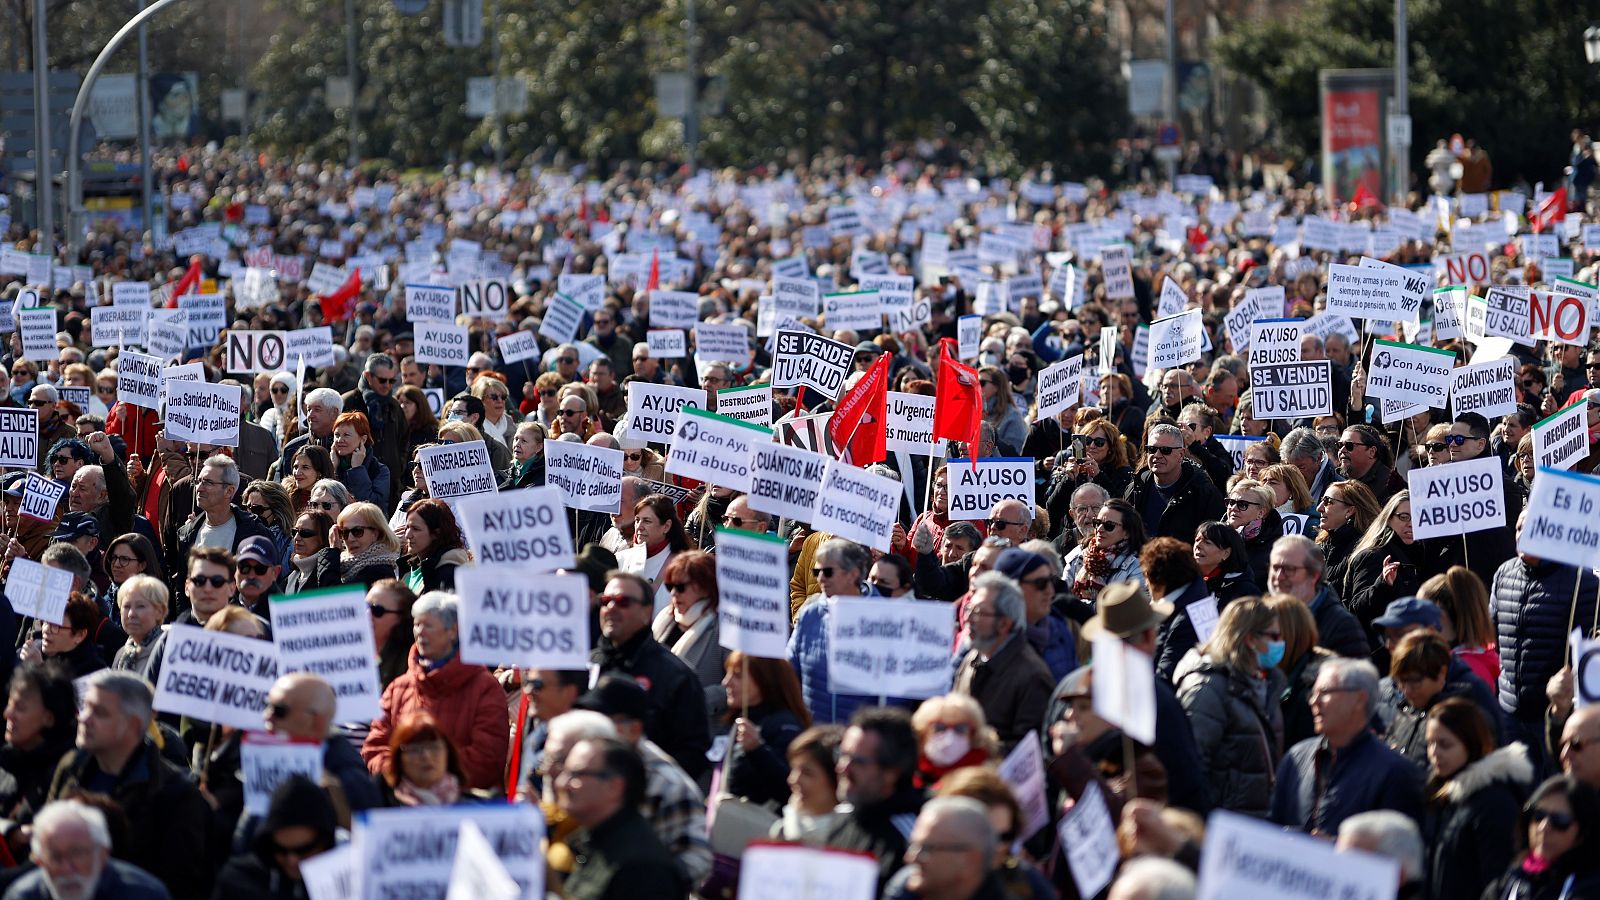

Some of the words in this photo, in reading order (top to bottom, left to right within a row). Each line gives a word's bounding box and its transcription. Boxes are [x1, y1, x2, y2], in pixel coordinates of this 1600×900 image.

[1333, 273, 1345, 282] Para
[1346, 274, 1351, 282] el
[1385, 278, 1398, 286] clero
[1446, 253, 1486, 284] NO
[414, 291, 449, 304] AY,USO
[464, 282, 504, 312] NO
[1340, 287, 1360, 296] siempre
[1362, 288, 1371, 298] hay
[1372, 289, 1390, 298] dinero.
[1404, 277, 1426, 294] MÁS
[1228, 296, 1260, 334] ROBAN
[1331, 298, 1343, 306] Para
[1344, 298, 1358, 308] salud
[1489, 293, 1502, 306] SE
[1507, 298, 1528, 317] VEN
[899, 303, 928, 330] NO
[1437, 318, 1449, 329] mil
[1486, 311, 1499, 328] TU
[1501, 317, 1528, 338] SALU
[1530, 293, 1585, 340] NO
[424, 331, 462, 344] AY,USO
[1154, 340, 1170, 352] ¡Con
[1172, 340, 1179, 348] la
[1180, 335, 1196, 347] salud
[1258, 328, 1298, 344] AY,USO
[230, 334, 284, 370] NO
[419, 346, 466, 360] ABUSOS.
[779, 335, 798, 352] SE
[802, 337, 851, 368] VENDE
[1154, 354, 1164, 362] no
[1176, 346, 1196, 360] juega!
[1250, 348, 1299, 364] ABUSOS.
[119, 357, 148, 376] ¿CUÁNTOS
[148, 361, 159, 378] MÁS
[778, 358, 793, 381] TU
[797, 358, 841, 390] SALUD
[1040, 366, 1068, 393] ¿CUÁNTOS
[1069, 360, 1081, 378] MÁS
[1254, 369, 1272, 386] SE
[1277, 364, 1328, 384] VENDE
[1393, 359, 1413, 370] Con
[1416, 362, 1449, 376] Ayuso
[1453, 366, 1494, 394] ¿CUÁNTOS
[1496, 363, 1512, 381] MÁS
[62, 389, 88, 402] VENDE
[120, 378, 137, 394] DEBEN
[138, 381, 157, 398] MORIR?
[840, 366, 882, 419] Estudiantes
[1040, 389, 1061, 409] DEBEN
[1062, 381, 1078, 400] MORIR?
[1370, 374, 1391, 387] mil
[1396, 378, 1446, 396] abusos.
[169, 397, 181, 406] Una
[183, 392, 210, 408] Sanidad
[213, 394, 238, 414] Pública
[641, 395, 698, 414] AY,USO
[720, 392, 766, 407] DESTRUCCIÓN
[1255, 390, 1275, 412] TU
[1279, 386, 1327, 411] SALUD
[1455, 393, 1485, 412] DEBEN
[1487, 387, 1513, 406] MORIR?
[0, 412, 35, 432] ENDE
[168, 412, 191, 429] gratuita
[192, 418, 197, 433] y
[199, 416, 207, 430] de
[210, 417, 238, 431] calidad!
[632, 416, 674, 435] ABUS
[1544, 413, 1581, 449] ¡RECUPERA
[0, 436, 34, 459] ALUD
[700, 432, 722, 446] Con
[726, 438, 748, 453] Ayu
[1542, 452, 1552, 468] TU
[1553, 433, 1585, 465] SANIDAD!
[424, 448, 487, 477] ¡¡¡MISERABLES!!!
[548, 458, 561, 468] Una
[563, 454, 590, 471] Sanidad
[592, 459, 620, 480] Pública
[672, 449, 697, 464] mil
[701, 456, 748, 477] abuso
[750, 450, 803, 478] ¿CUÁNTOS
[803, 459, 826, 483] MÁS
[430, 480, 461, 498] ¡Recortan
[462, 474, 493, 493] Sanidad!
[548, 473, 570, 492] gratuita
[570, 481, 576, 498] y
[576, 480, 586, 495] de
[588, 483, 620, 497] calidad!
[649, 482, 686, 499] ENDE
[751, 478, 782, 500] DEBEN
[826, 468, 878, 503] ¡Recortemos
[878, 492, 888, 510] ya
[889, 497, 895, 509] a
[961, 469, 1027, 488] AY,USO
[1427, 473, 1493, 499] AY,USO
[22, 494, 49, 518] ALUD.
[1418, 500, 1501, 526] ABUSOS.
[1553, 488, 1571, 509] Es
[1580, 492, 1593, 514] lo
[483, 504, 554, 532] AY,USO
[821, 498, 833, 517] los
[836, 507, 890, 537] recortadores!
[1530, 516, 1563, 540] ¡Nos
[480, 536, 568, 563] ABUSOS.
[482, 589, 572, 616] AY,USO
[276, 606, 355, 627] DESTRUCCIÓN
[280, 631, 362, 652] PROGRAMADA
[469, 623, 583, 653] ABUSOS.
[168, 636, 253, 674] ¿CUÁNTOS
[303, 655, 367, 674] ATENCIÓN
[166, 671, 217, 700] DEBEN
